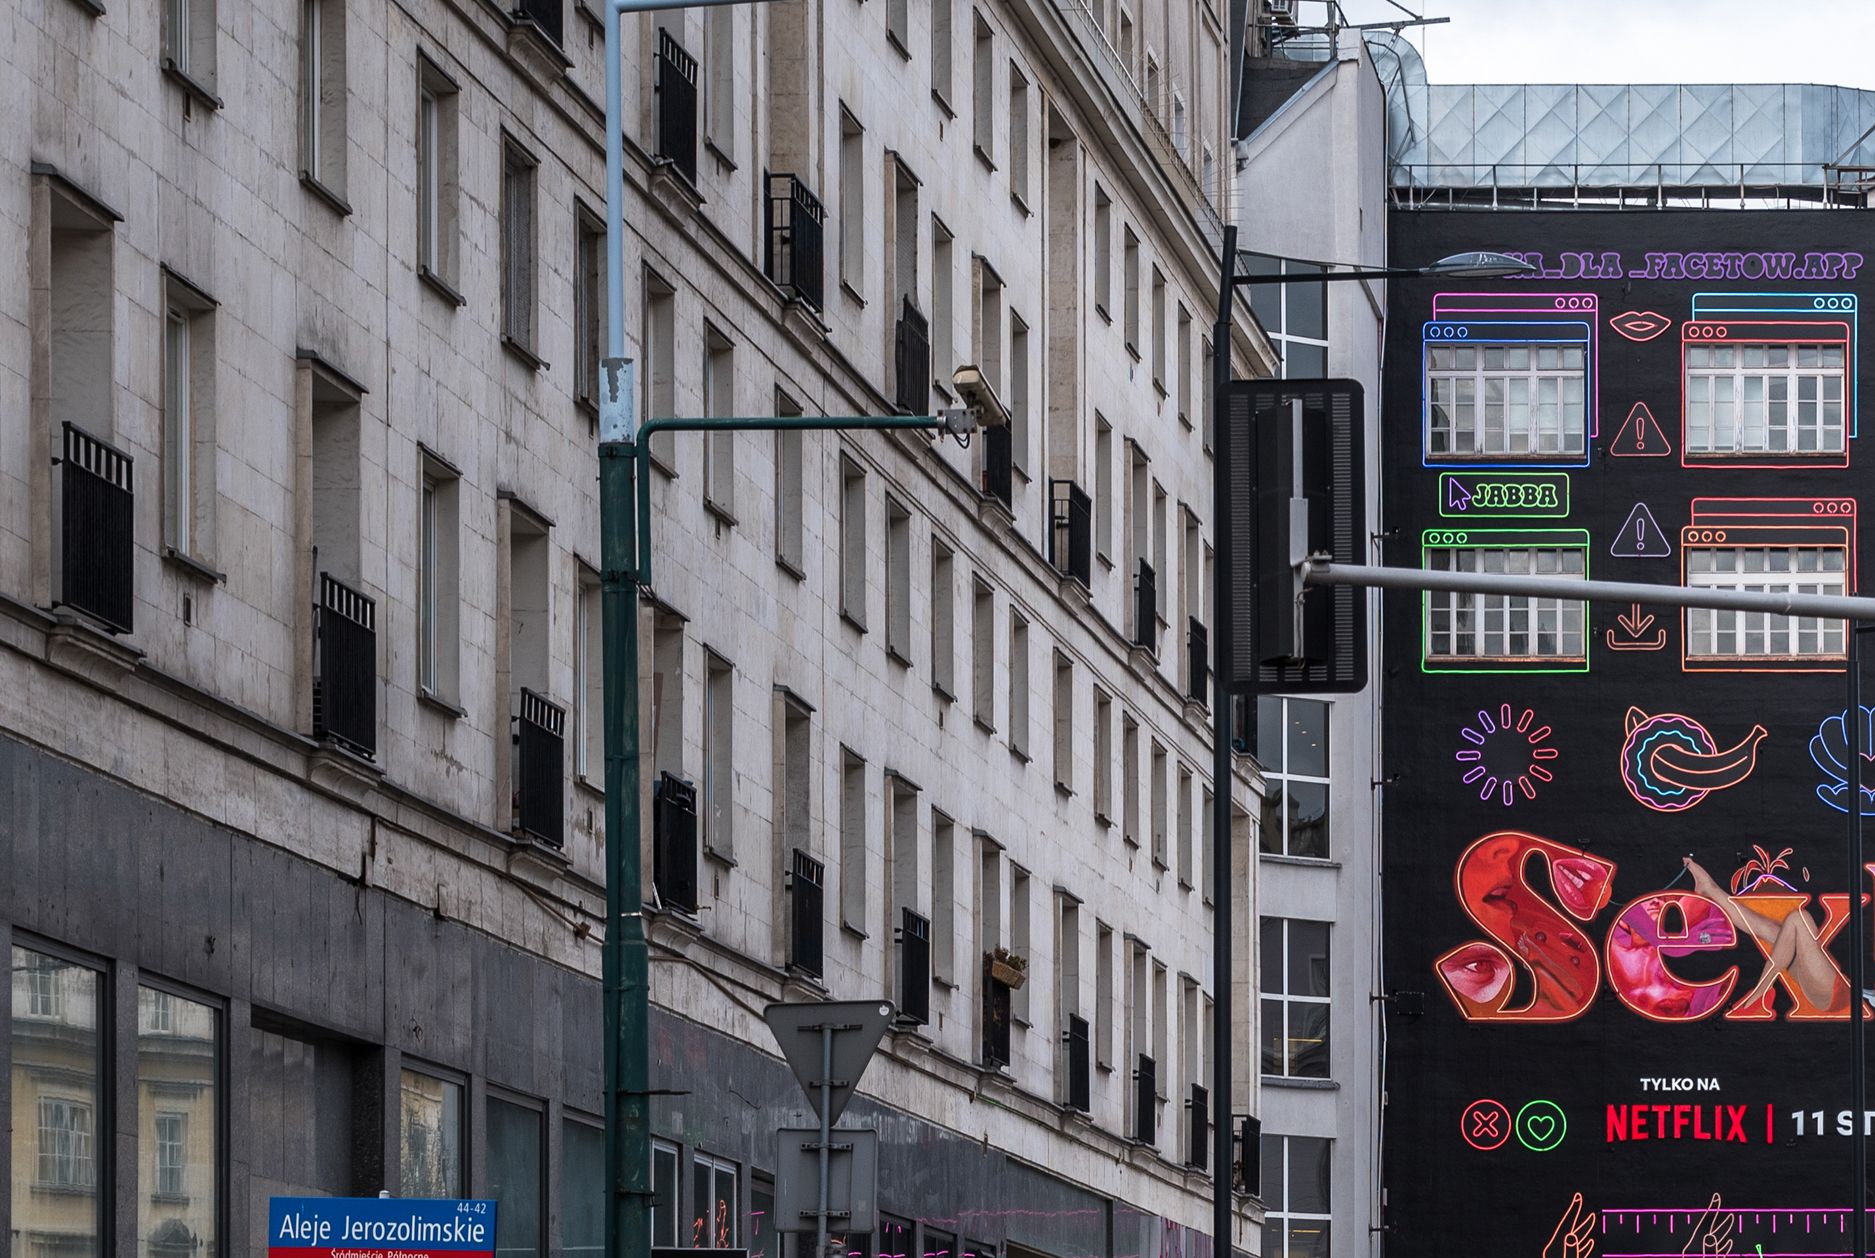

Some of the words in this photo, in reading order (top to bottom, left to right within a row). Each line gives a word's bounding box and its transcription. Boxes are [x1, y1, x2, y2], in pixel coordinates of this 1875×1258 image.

[1472, 483, 1559, 507] JABBA
[1639, 1077, 1694, 1092] TYLKO
[1696, 1077, 1721, 1092] NA
[1606, 1103, 1748, 1144] NETFLIX
[1791, 1110, 1826, 1136] 11
[456, 1202, 487, 1215] 44-42
[279, 1213, 331, 1247] Aleje
[341, 1214, 486, 1243] Jerozolimskie
